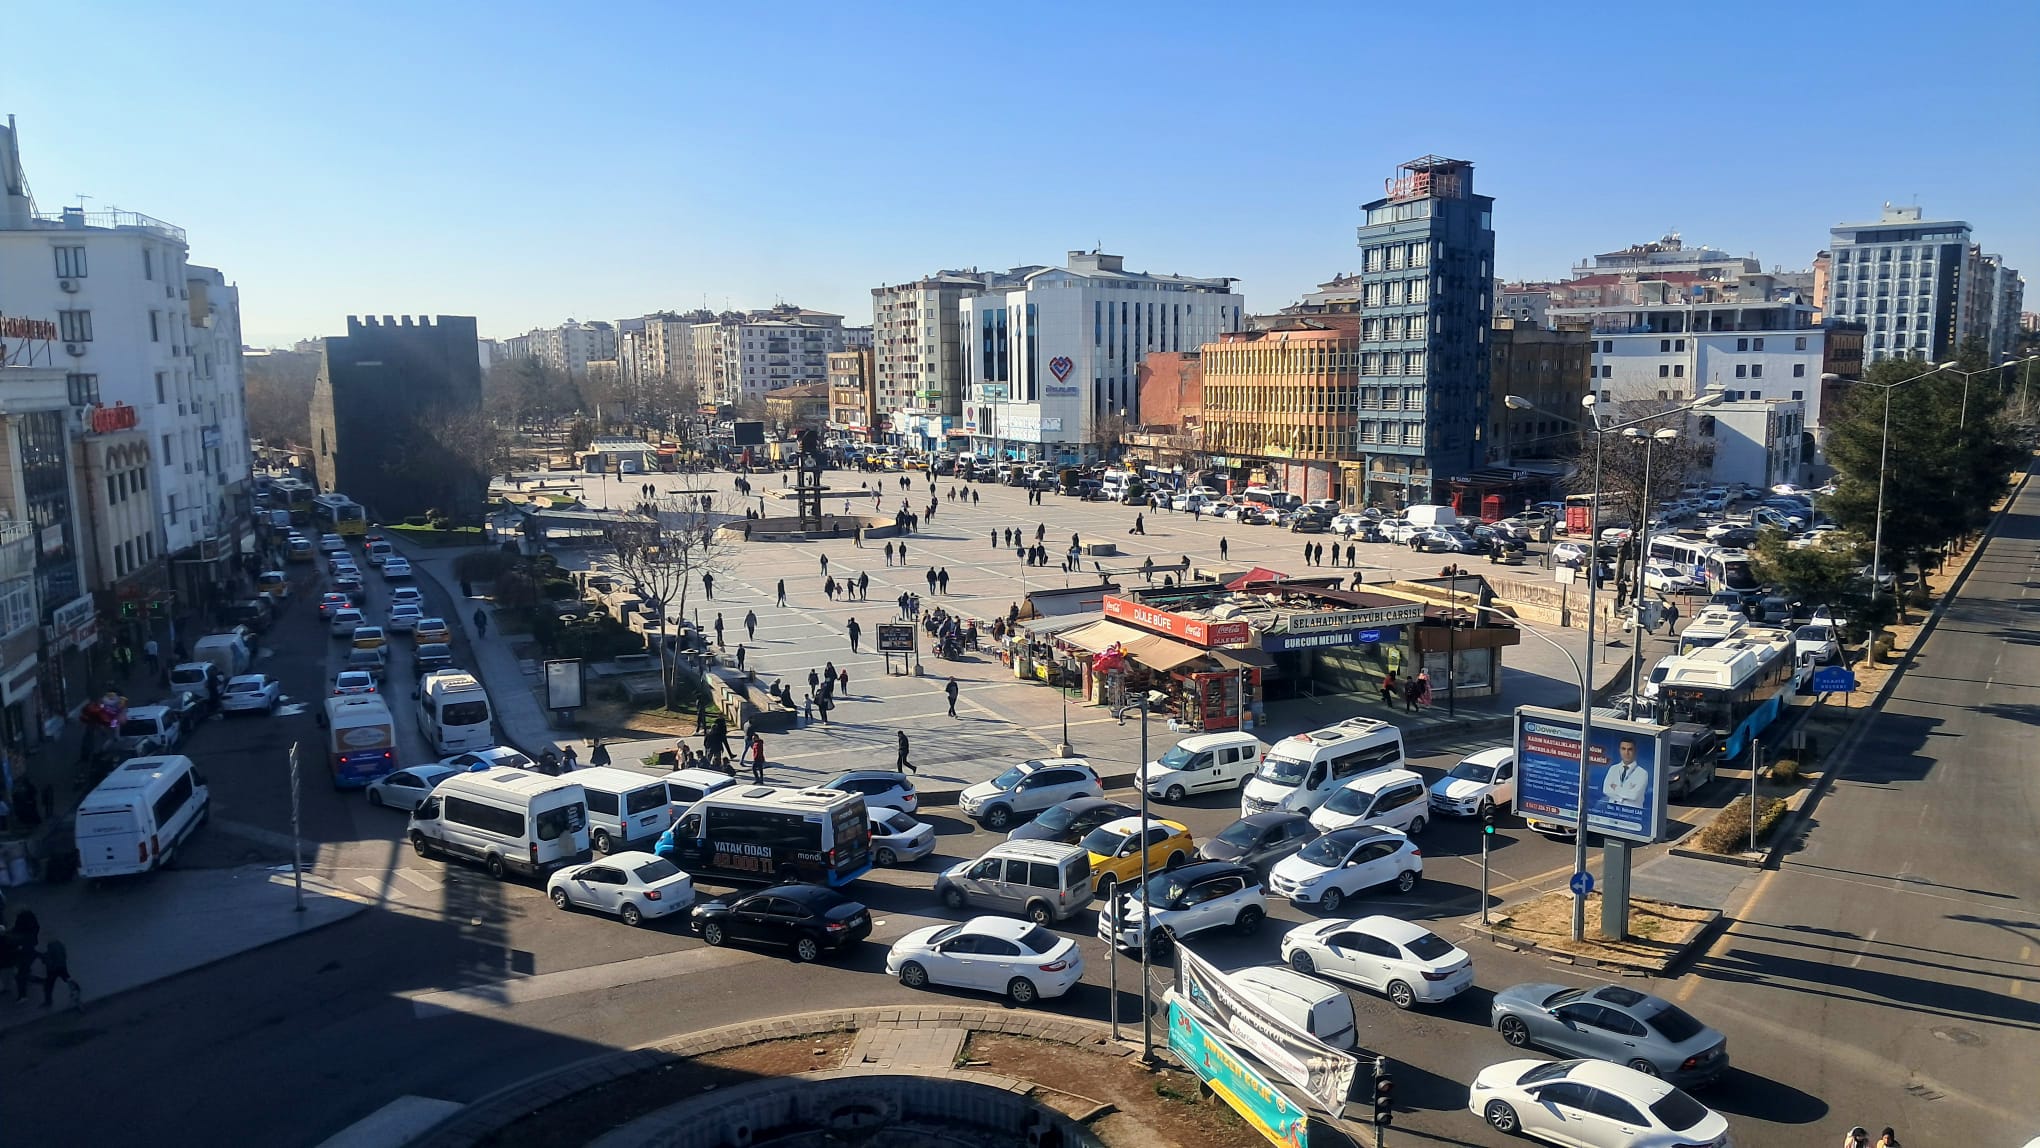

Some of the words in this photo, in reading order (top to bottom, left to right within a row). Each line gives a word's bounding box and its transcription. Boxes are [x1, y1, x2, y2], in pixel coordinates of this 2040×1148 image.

[1153, 614, 1172, 630] BÜFE
[1285, 636, 1318, 649] BURCUM
[1319, 633, 1353, 646] MEDİKAL
[714, 841, 742, 855] YATAK
[744, 844, 772, 858] ODASI
[797, 851, 822, 862] mondi
